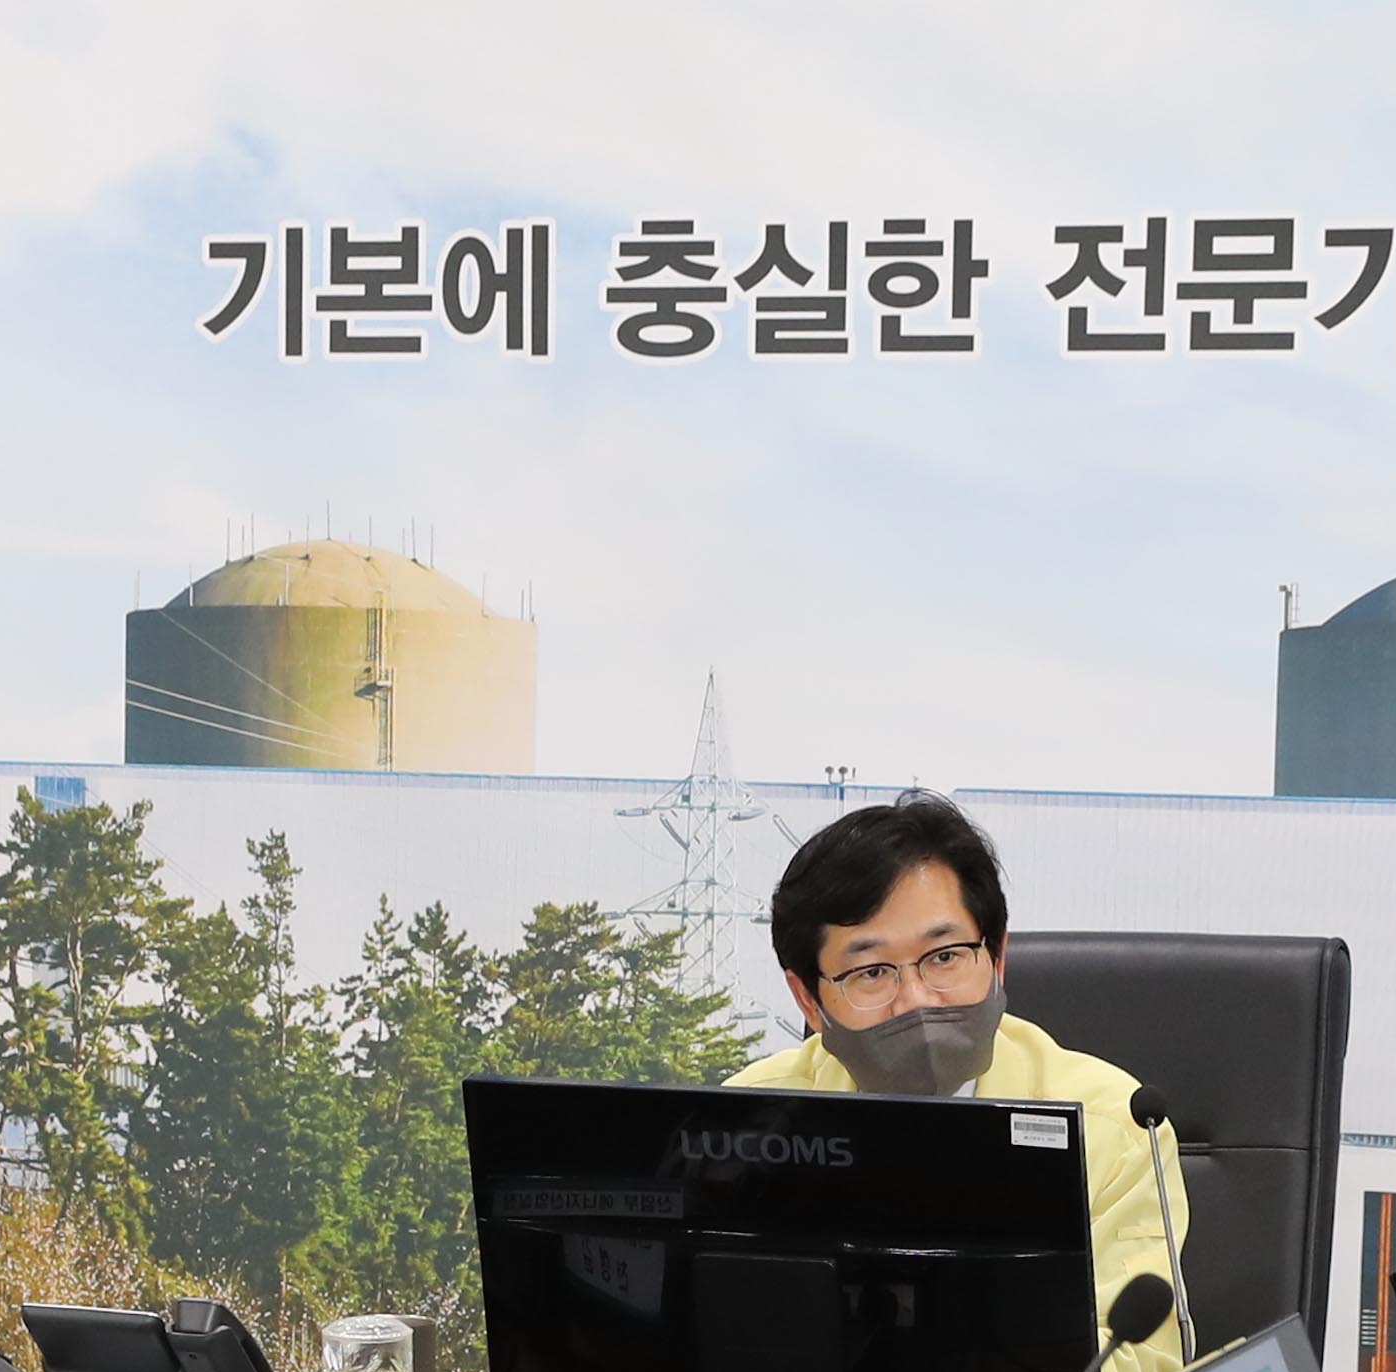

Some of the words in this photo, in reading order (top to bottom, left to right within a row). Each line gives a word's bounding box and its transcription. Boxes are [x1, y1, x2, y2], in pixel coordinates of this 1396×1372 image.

[205, 225, 549, 356] 기본에
[606, 220, 989, 357] 충실한
[681, 1131, 854, 1167] LUCOMS
